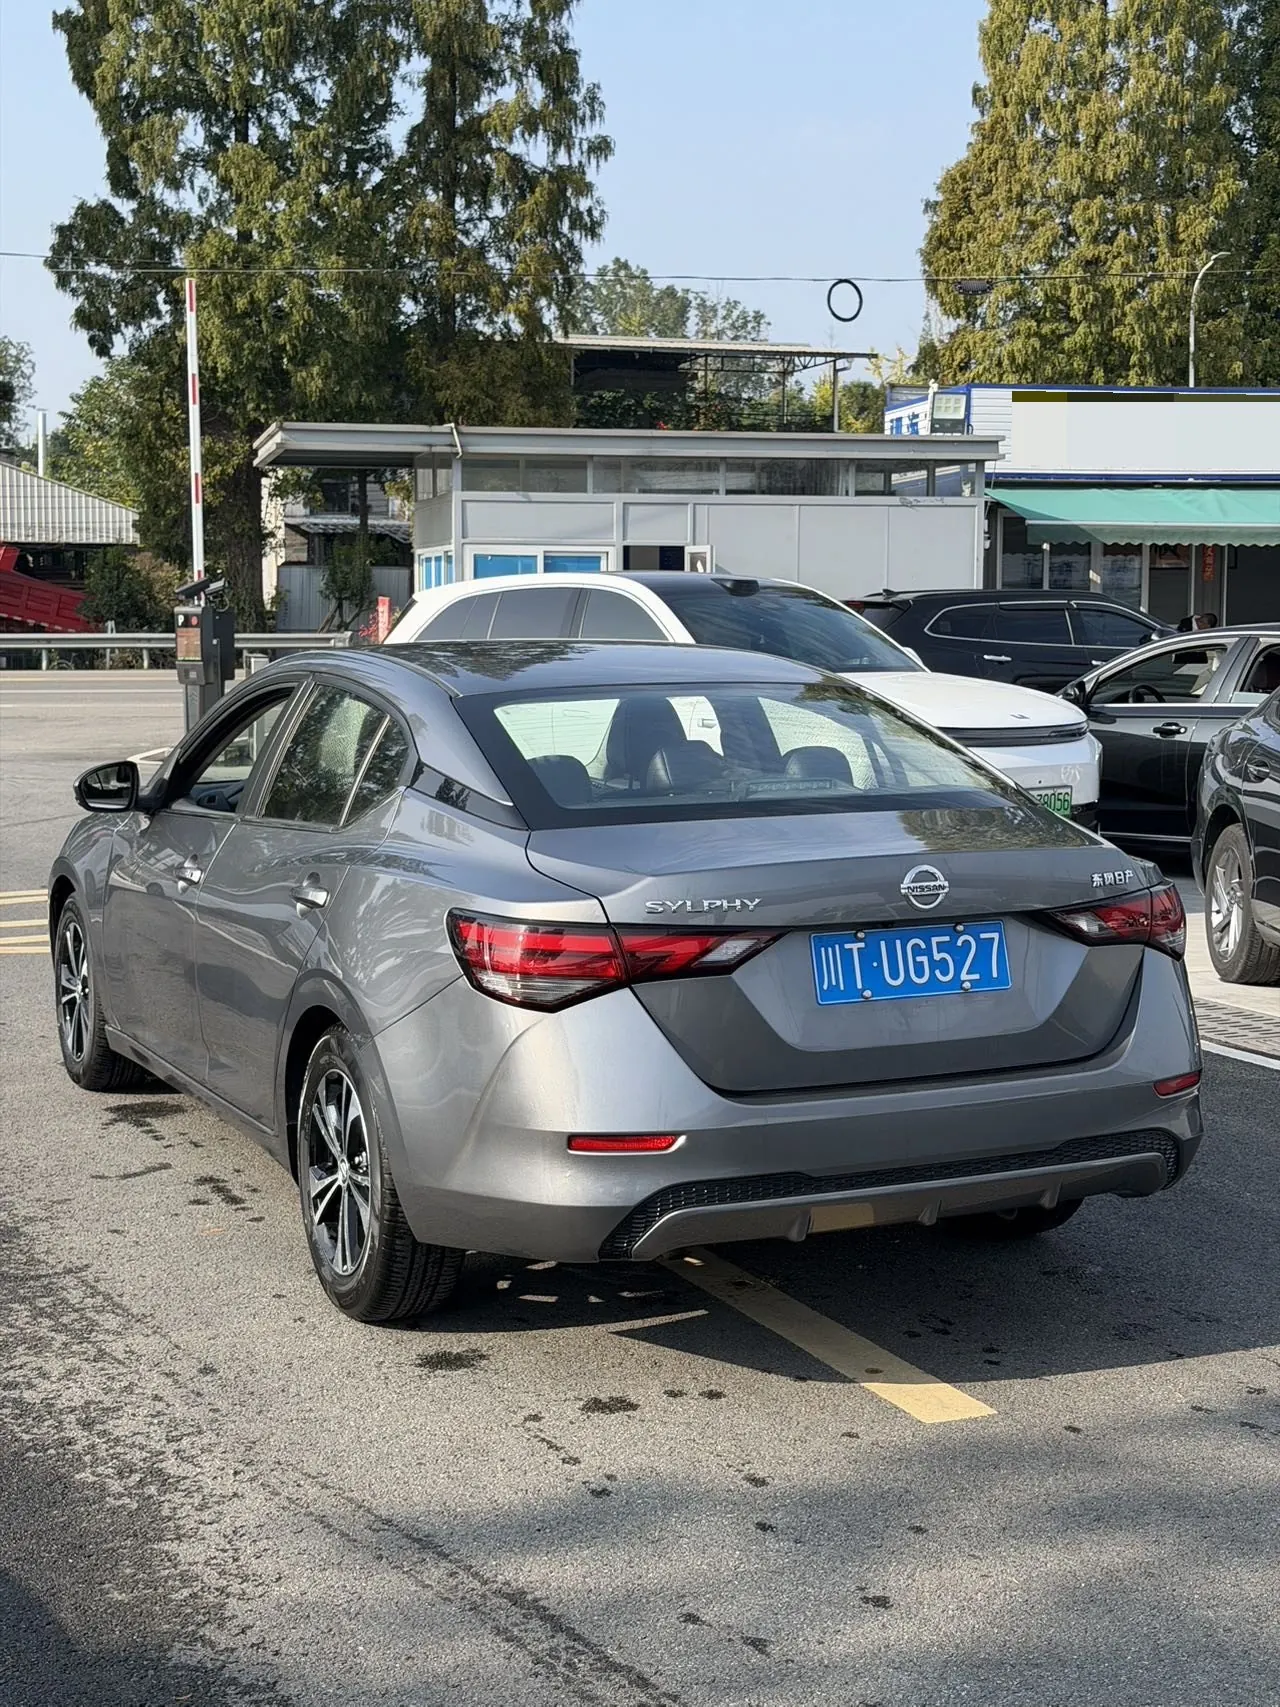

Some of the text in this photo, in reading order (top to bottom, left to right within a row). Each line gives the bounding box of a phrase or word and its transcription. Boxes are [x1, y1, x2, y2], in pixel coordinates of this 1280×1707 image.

[178, 614, 185, 626] P
[1091, 869, 1134, 888] 东风日产
[907, 884, 945, 893] NISSAN
[644, 898, 762, 914] SYLPHY
[820, 932, 1000, 991] 川T·UG527
